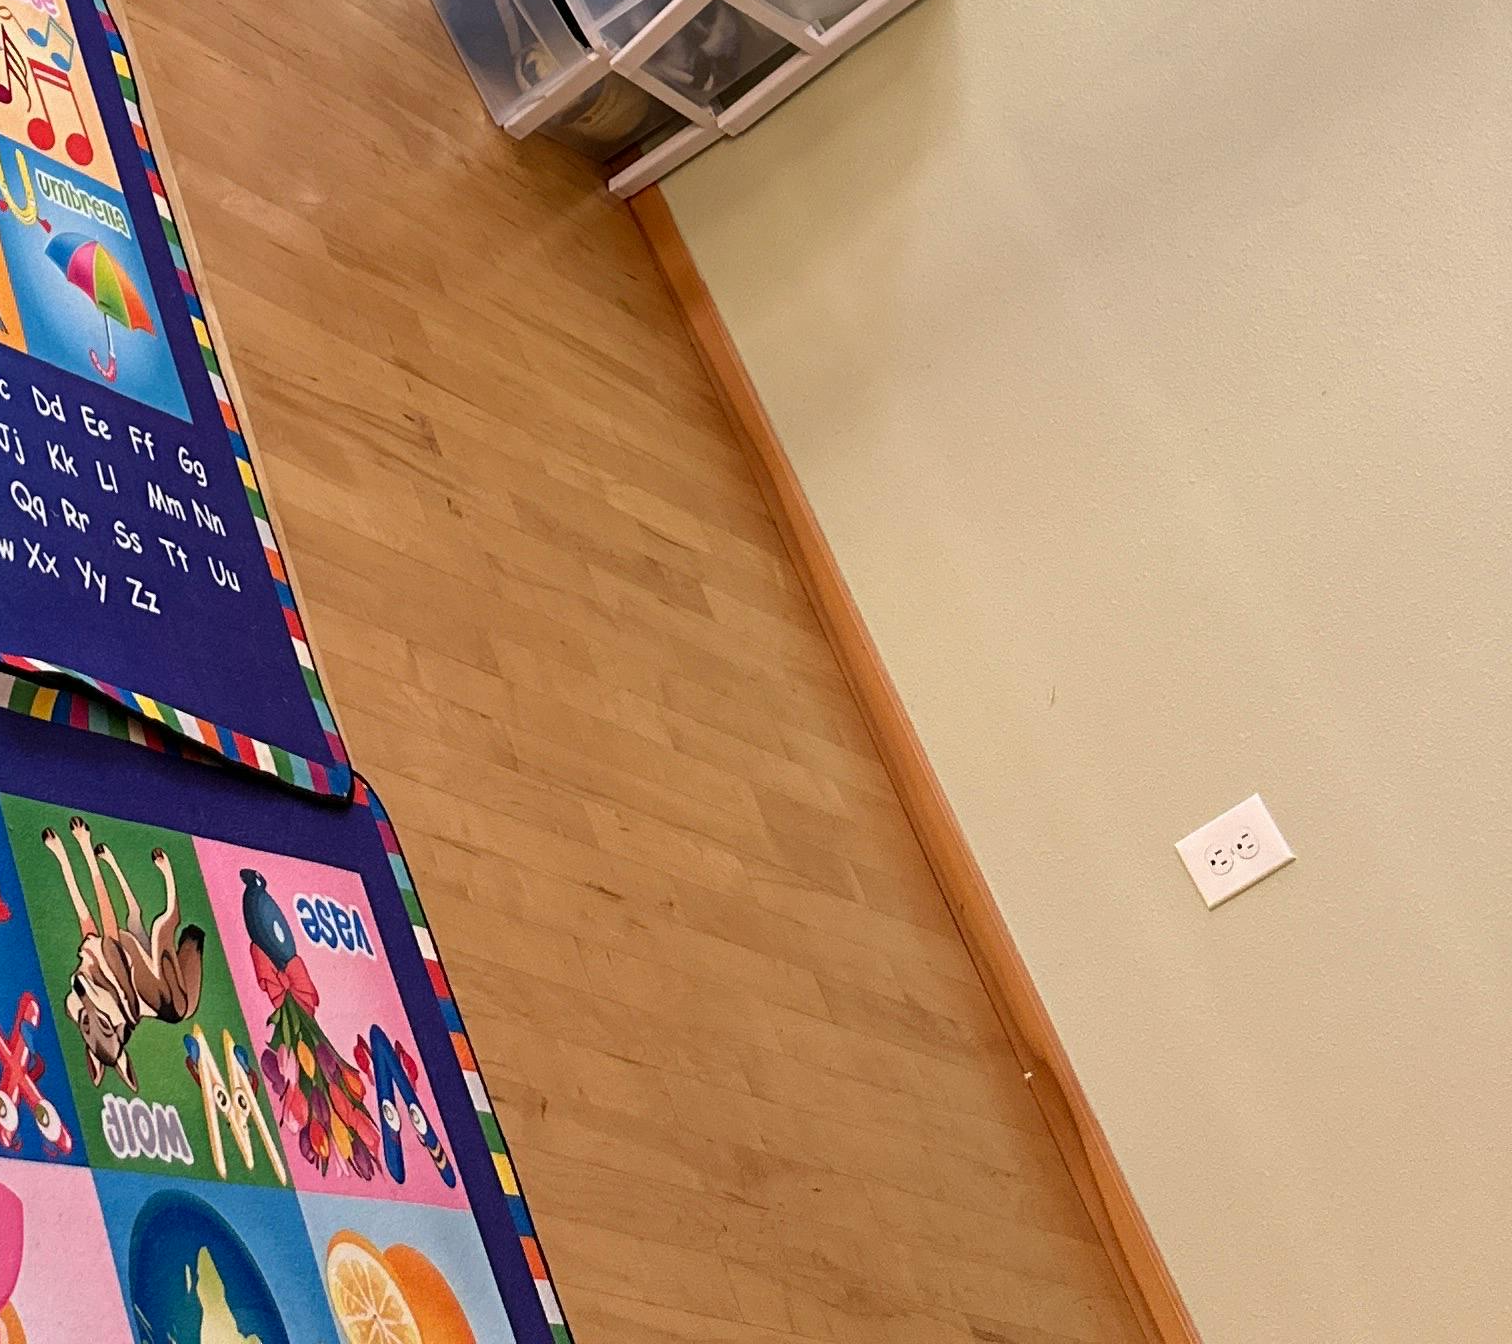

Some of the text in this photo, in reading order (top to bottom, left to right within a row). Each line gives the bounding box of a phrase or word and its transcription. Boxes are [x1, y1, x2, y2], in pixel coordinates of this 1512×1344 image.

[37, 169, 129, 239] umbrella
[31, 385, 66, 423] Dd
[80, 405, 112, 441] Ee
[128, 425, 155, 461] Ff
[178, 446, 208, 488] Gg
[10, 480, 48, 527] Qq
[60, 497, 90, 533] Rr
[113, 520, 143, 554] Ss
[158, 537, 189, 573] Tt
[207, 556, 241, 593] Uu
[46, 440, 79, 478] Kk
[95, 460, 119, 494] Ll
[147, 481, 187, 522] Mm
[191, 498, 227, 537] Nn
[23, 537, 60, 578] Xx
[74, 556, 107, 603] Yy
[125, 576, 161, 615] Zz
[299, 896, 374, 956] vase
[102, 1095, 192, 1163] wolf
[187, 1023, 287, 1185] W
[368, 1023, 456, 1189] V
